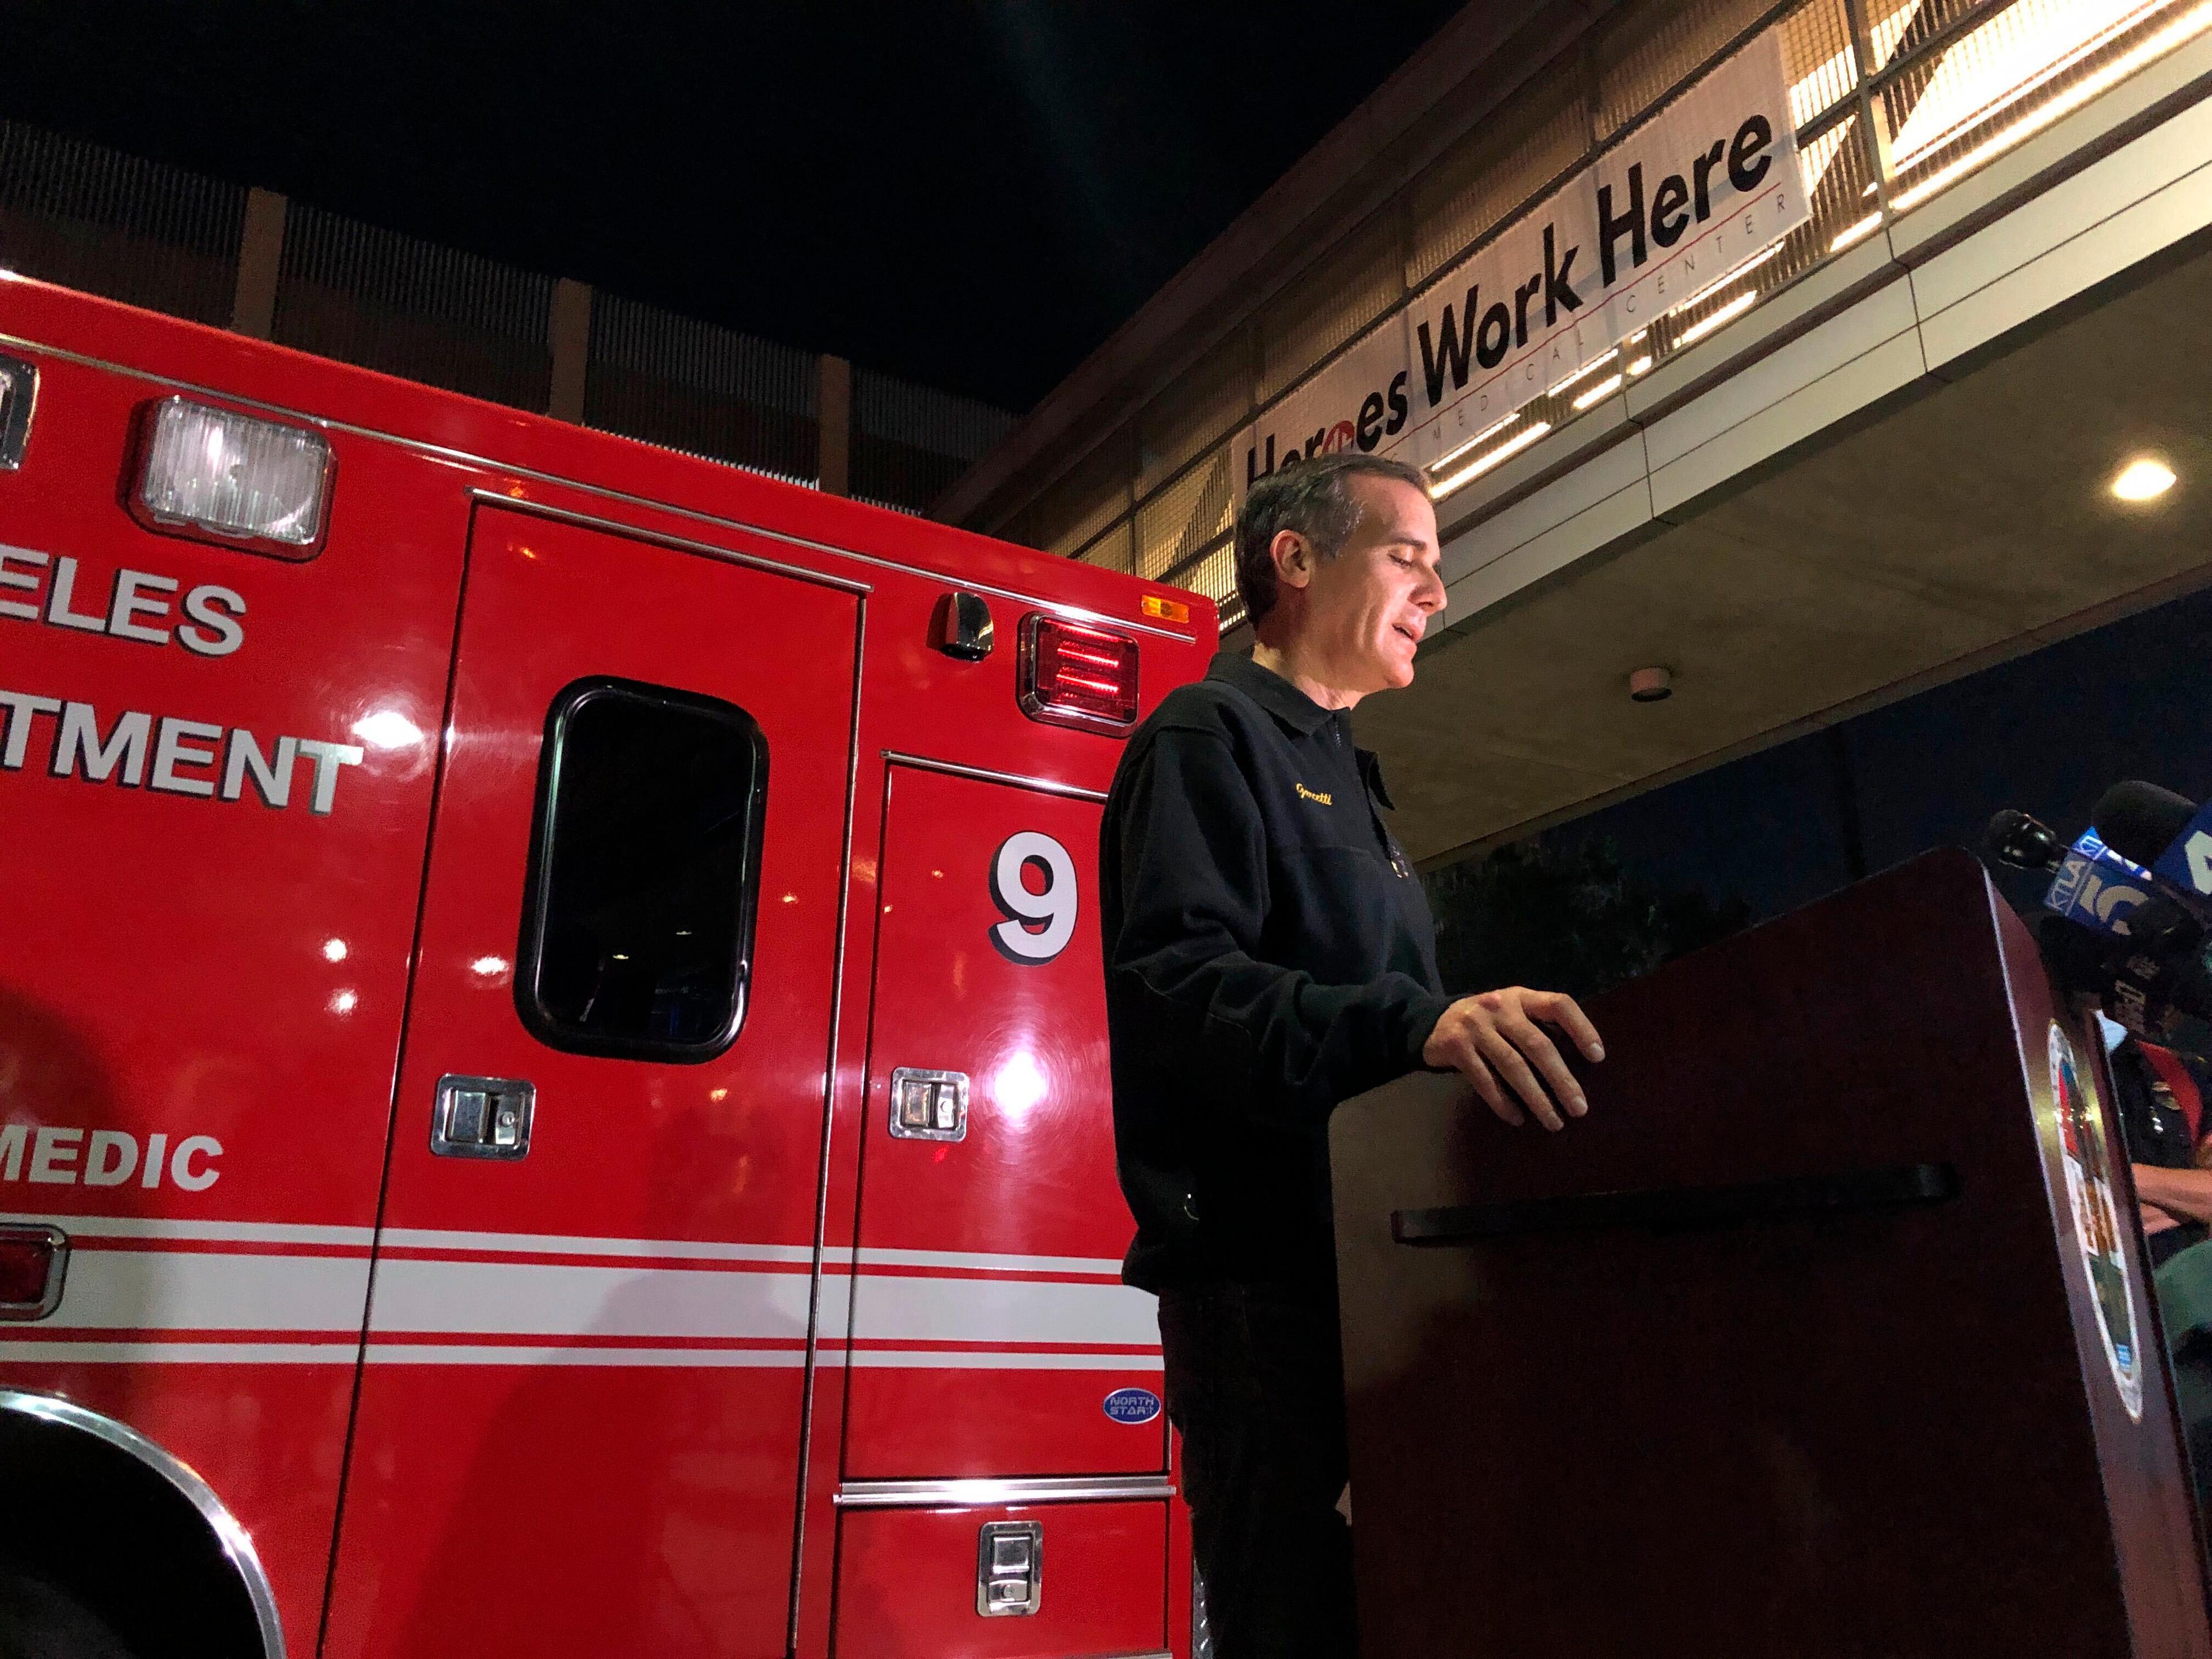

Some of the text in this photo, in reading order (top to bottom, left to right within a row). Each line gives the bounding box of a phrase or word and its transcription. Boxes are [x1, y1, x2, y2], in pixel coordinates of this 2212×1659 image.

[1416, 221, 1584, 408] Work
[1597, 114, 1772, 289] Here
[1432, 193, 1785, 441] MEDICAL CENTER
[988, 830, 1078, 965] 9
[1109, 1396, 1154, 1406] NORTH
